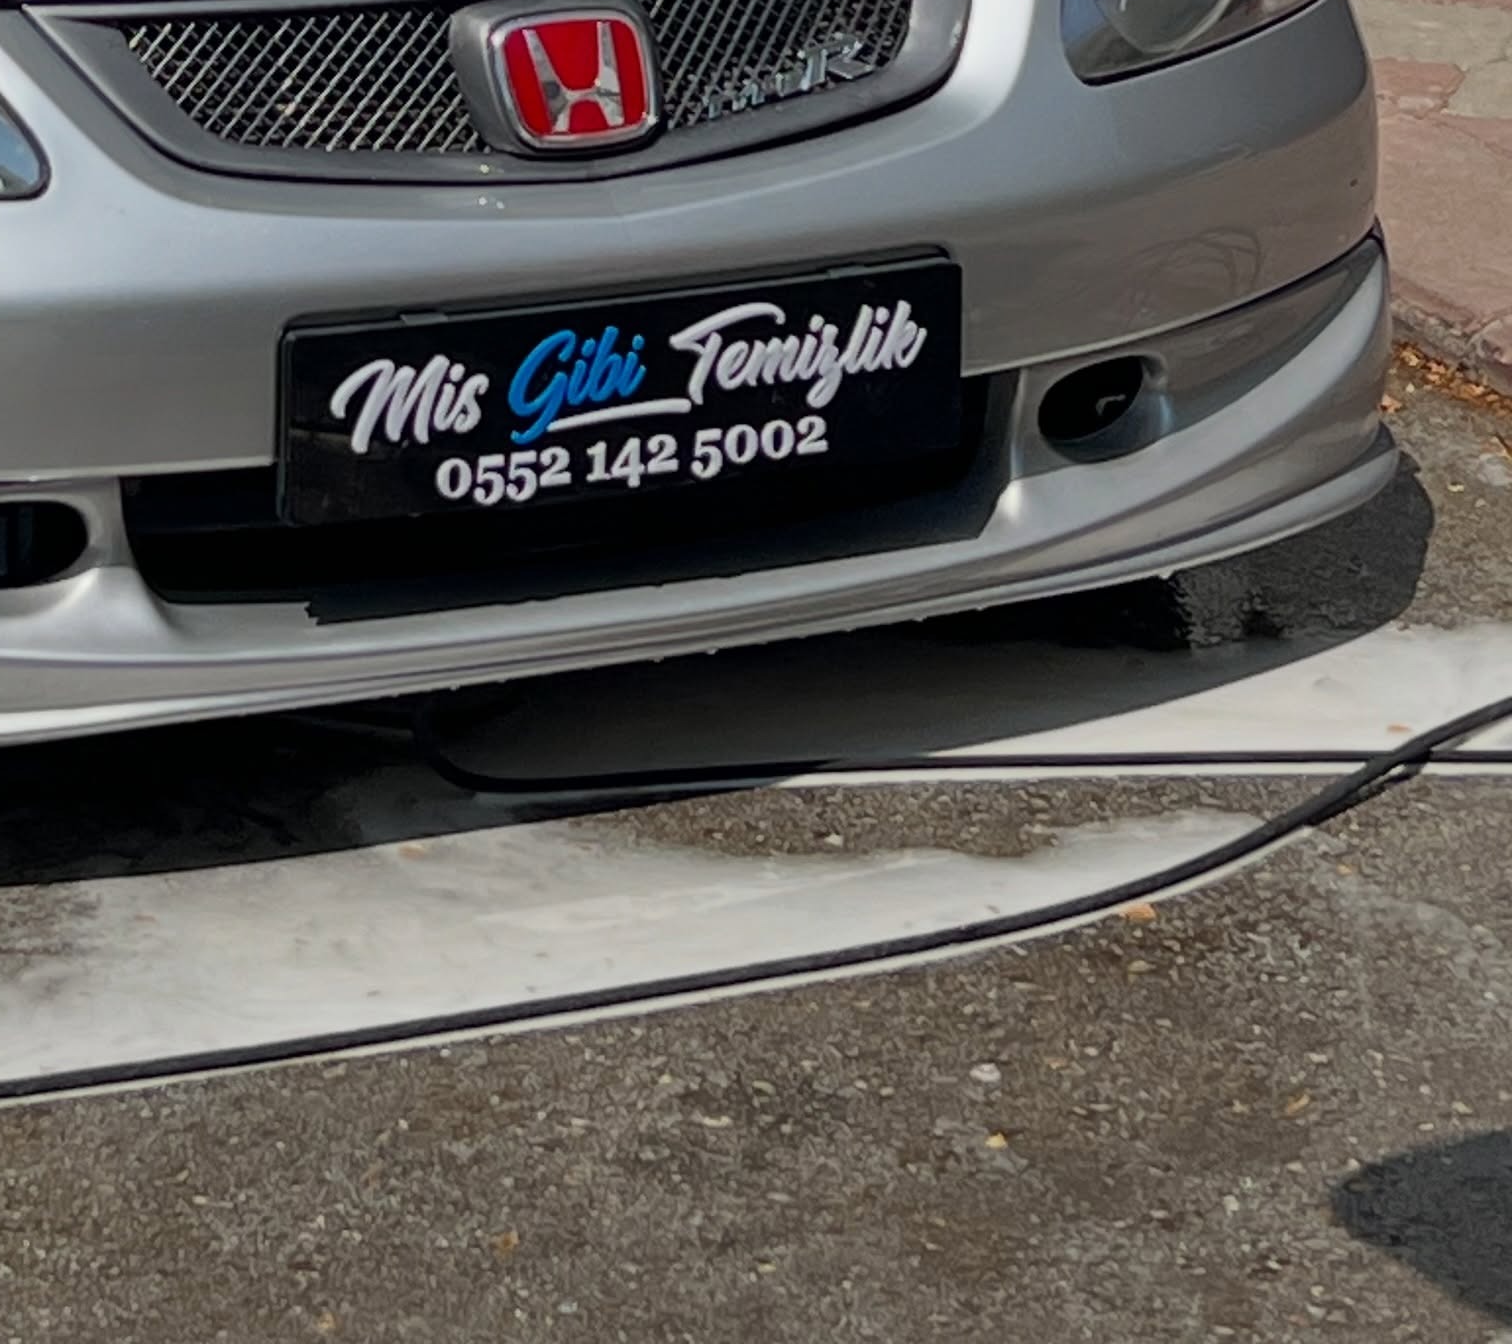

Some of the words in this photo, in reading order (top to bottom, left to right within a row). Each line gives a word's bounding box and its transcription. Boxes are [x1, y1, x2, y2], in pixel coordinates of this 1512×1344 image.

[330, 355, 490, 454] Mis
[507, 325, 647, 445] Gibi
[669, 300, 928, 410] Temizlik
[434, 444, 573, 507] 0552
[586, 433, 680, 488] 142
[690, 415, 830, 480] 5002
